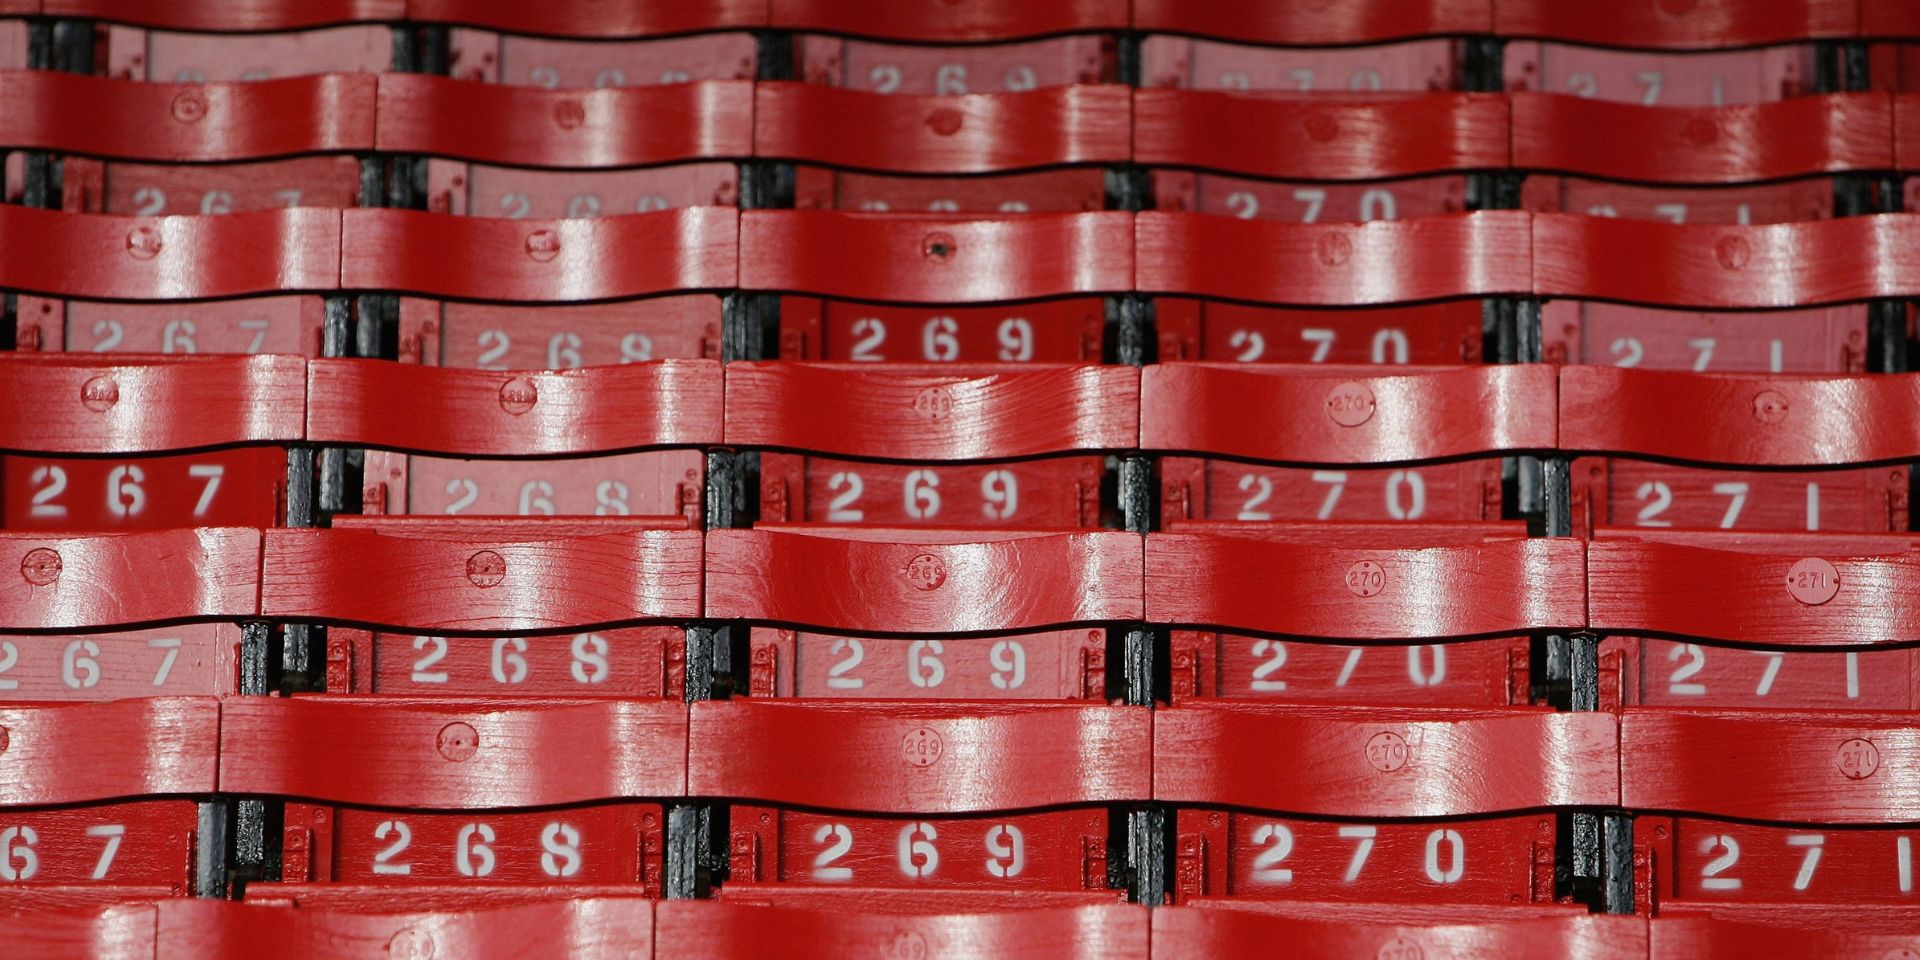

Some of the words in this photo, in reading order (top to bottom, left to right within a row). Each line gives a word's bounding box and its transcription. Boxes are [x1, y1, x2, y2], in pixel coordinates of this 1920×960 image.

[869, 63, 1037, 95] 269
[1567, 71, 1724, 107] 271
[1226, 188, 1397, 223] 270
[92, 319, 269, 353] 267
[477, 329, 653, 370] 268
[851, 316, 1033, 361] 269
[1229, 328, 1409, 364] 270
[1609, 337, 1783, 372] 271
[1334, 396, 1365, 411] 270
[30, 464, 224, 517] 267
[445, 478, 629, 515] 268
[827, 469, 1018, 521] 269
[1237, 470, 1425, 520] 270
[1636, 481, 1819, 531] 271
[911, 566, 944, 580] 269
[1350, 571, 1381, 587] 270
[1798, 572, 1826, 588] 271
[411, 634, 609, 683] 268
[827, 639, 1026, 689] 269
[1668, 644, 1859, 698] 271
[905, 739, 939, 755] 269
[1370, 743, 1404, 761] 270
[1843, 751, 1872, 767] 271
[373, 821, 581, 877] 268
[813, 822, 1024, 882] 269
[1252, 824, 1464, 883] 270
[1700, 835, 1911, 892] 271
